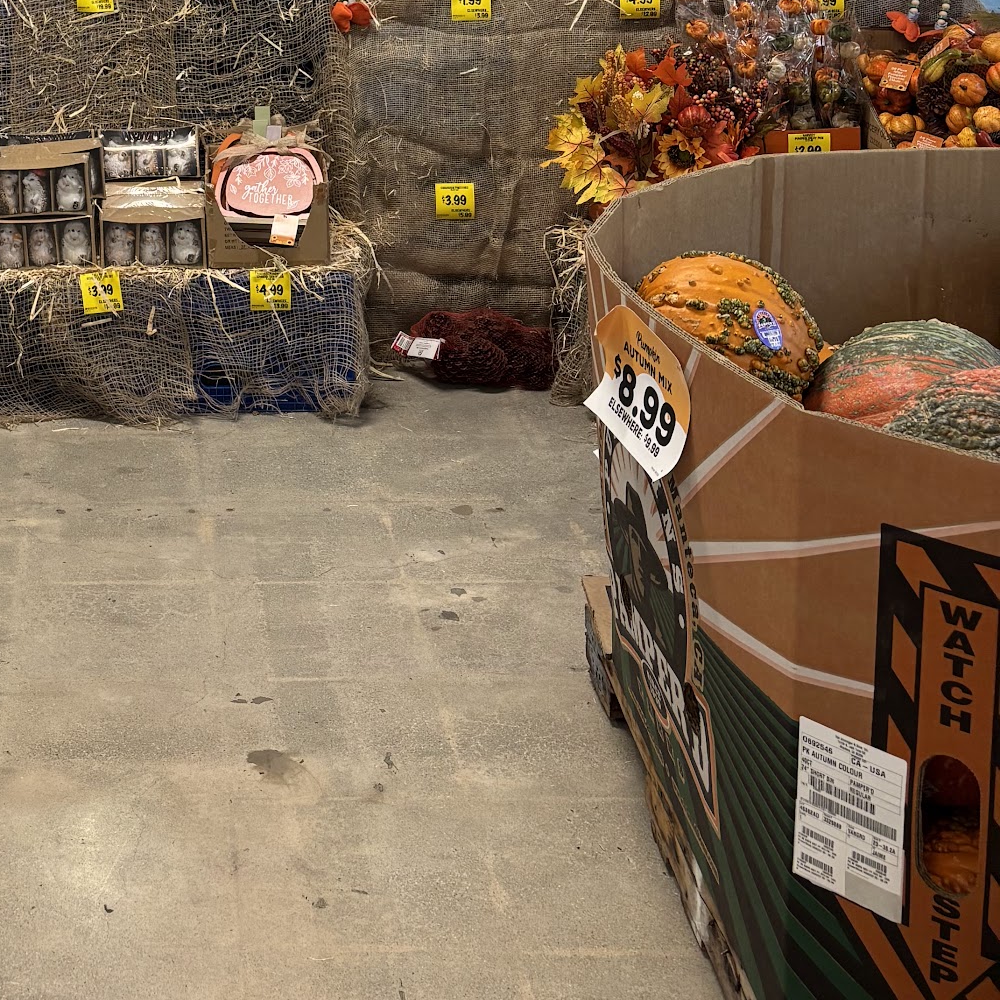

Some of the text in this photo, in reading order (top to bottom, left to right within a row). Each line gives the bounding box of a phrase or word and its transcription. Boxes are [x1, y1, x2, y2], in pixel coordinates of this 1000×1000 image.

[242, 180, 279, 200] gather
[248, 193, 293, 206] TOGETHER
[442, 194, 467, 206] $3.99
[623, 341, 673, 396] AUTUMN MIX
[614, 353, 677, 447] $8.99
[608, 396, 661, 458] ELSEWHERE: $9.99
[940, 600, 983, 735] WATCH
[802, 746, 863, 780] PK AUTUMN COLOUR
[851, 757, 862, 768] CA
[869, 766, 886, 779] USA
[929, 893, 961, 984] STEP
